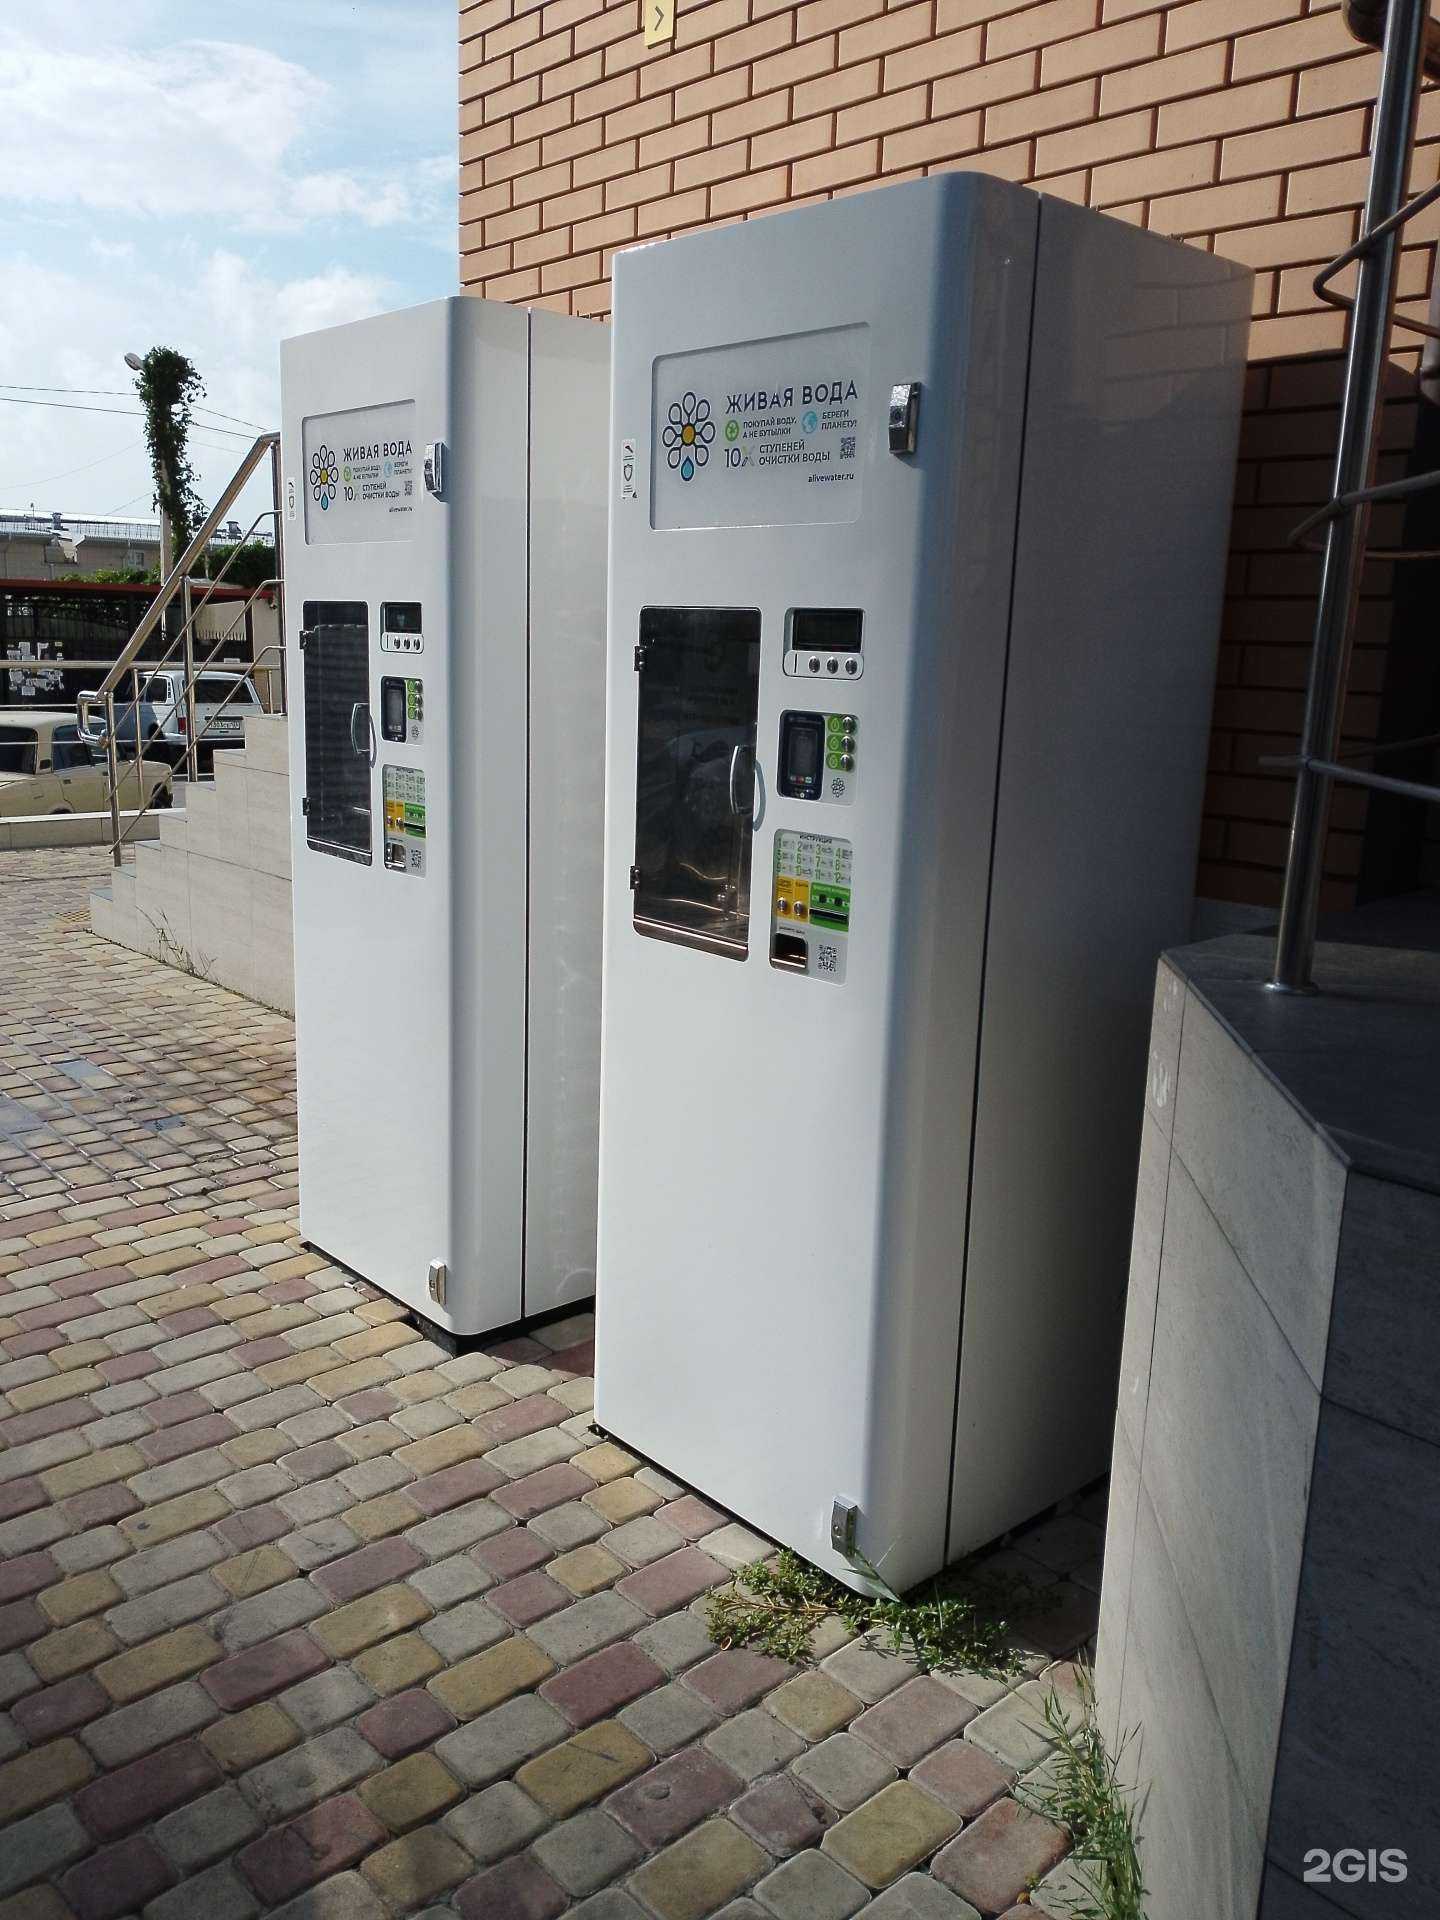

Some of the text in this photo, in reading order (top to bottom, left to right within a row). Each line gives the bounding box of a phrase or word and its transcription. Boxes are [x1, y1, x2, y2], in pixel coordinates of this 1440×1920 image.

[725, 380, 858, 414] ЖИВАЯ ВОДА
[822, 409, 849, 420] БЕРЕГИ
[743, 417, 776, 429] ПОКУПАЙ
[742, 427, 791, 439] А НЕ БУТЫЛКИ
[343, 440, 412, 462] ЖИВАЯ ВОДА
[759, 439, 805, 454] СТУПЕНЕЙ
[724, 448, 741, 468] 10
[758, 452, 830, 466] ОЧИСТКИ ВОДЫ
[808, 472, 855, 483] alivewater.ru
[343, 486, 354, 501] 10
